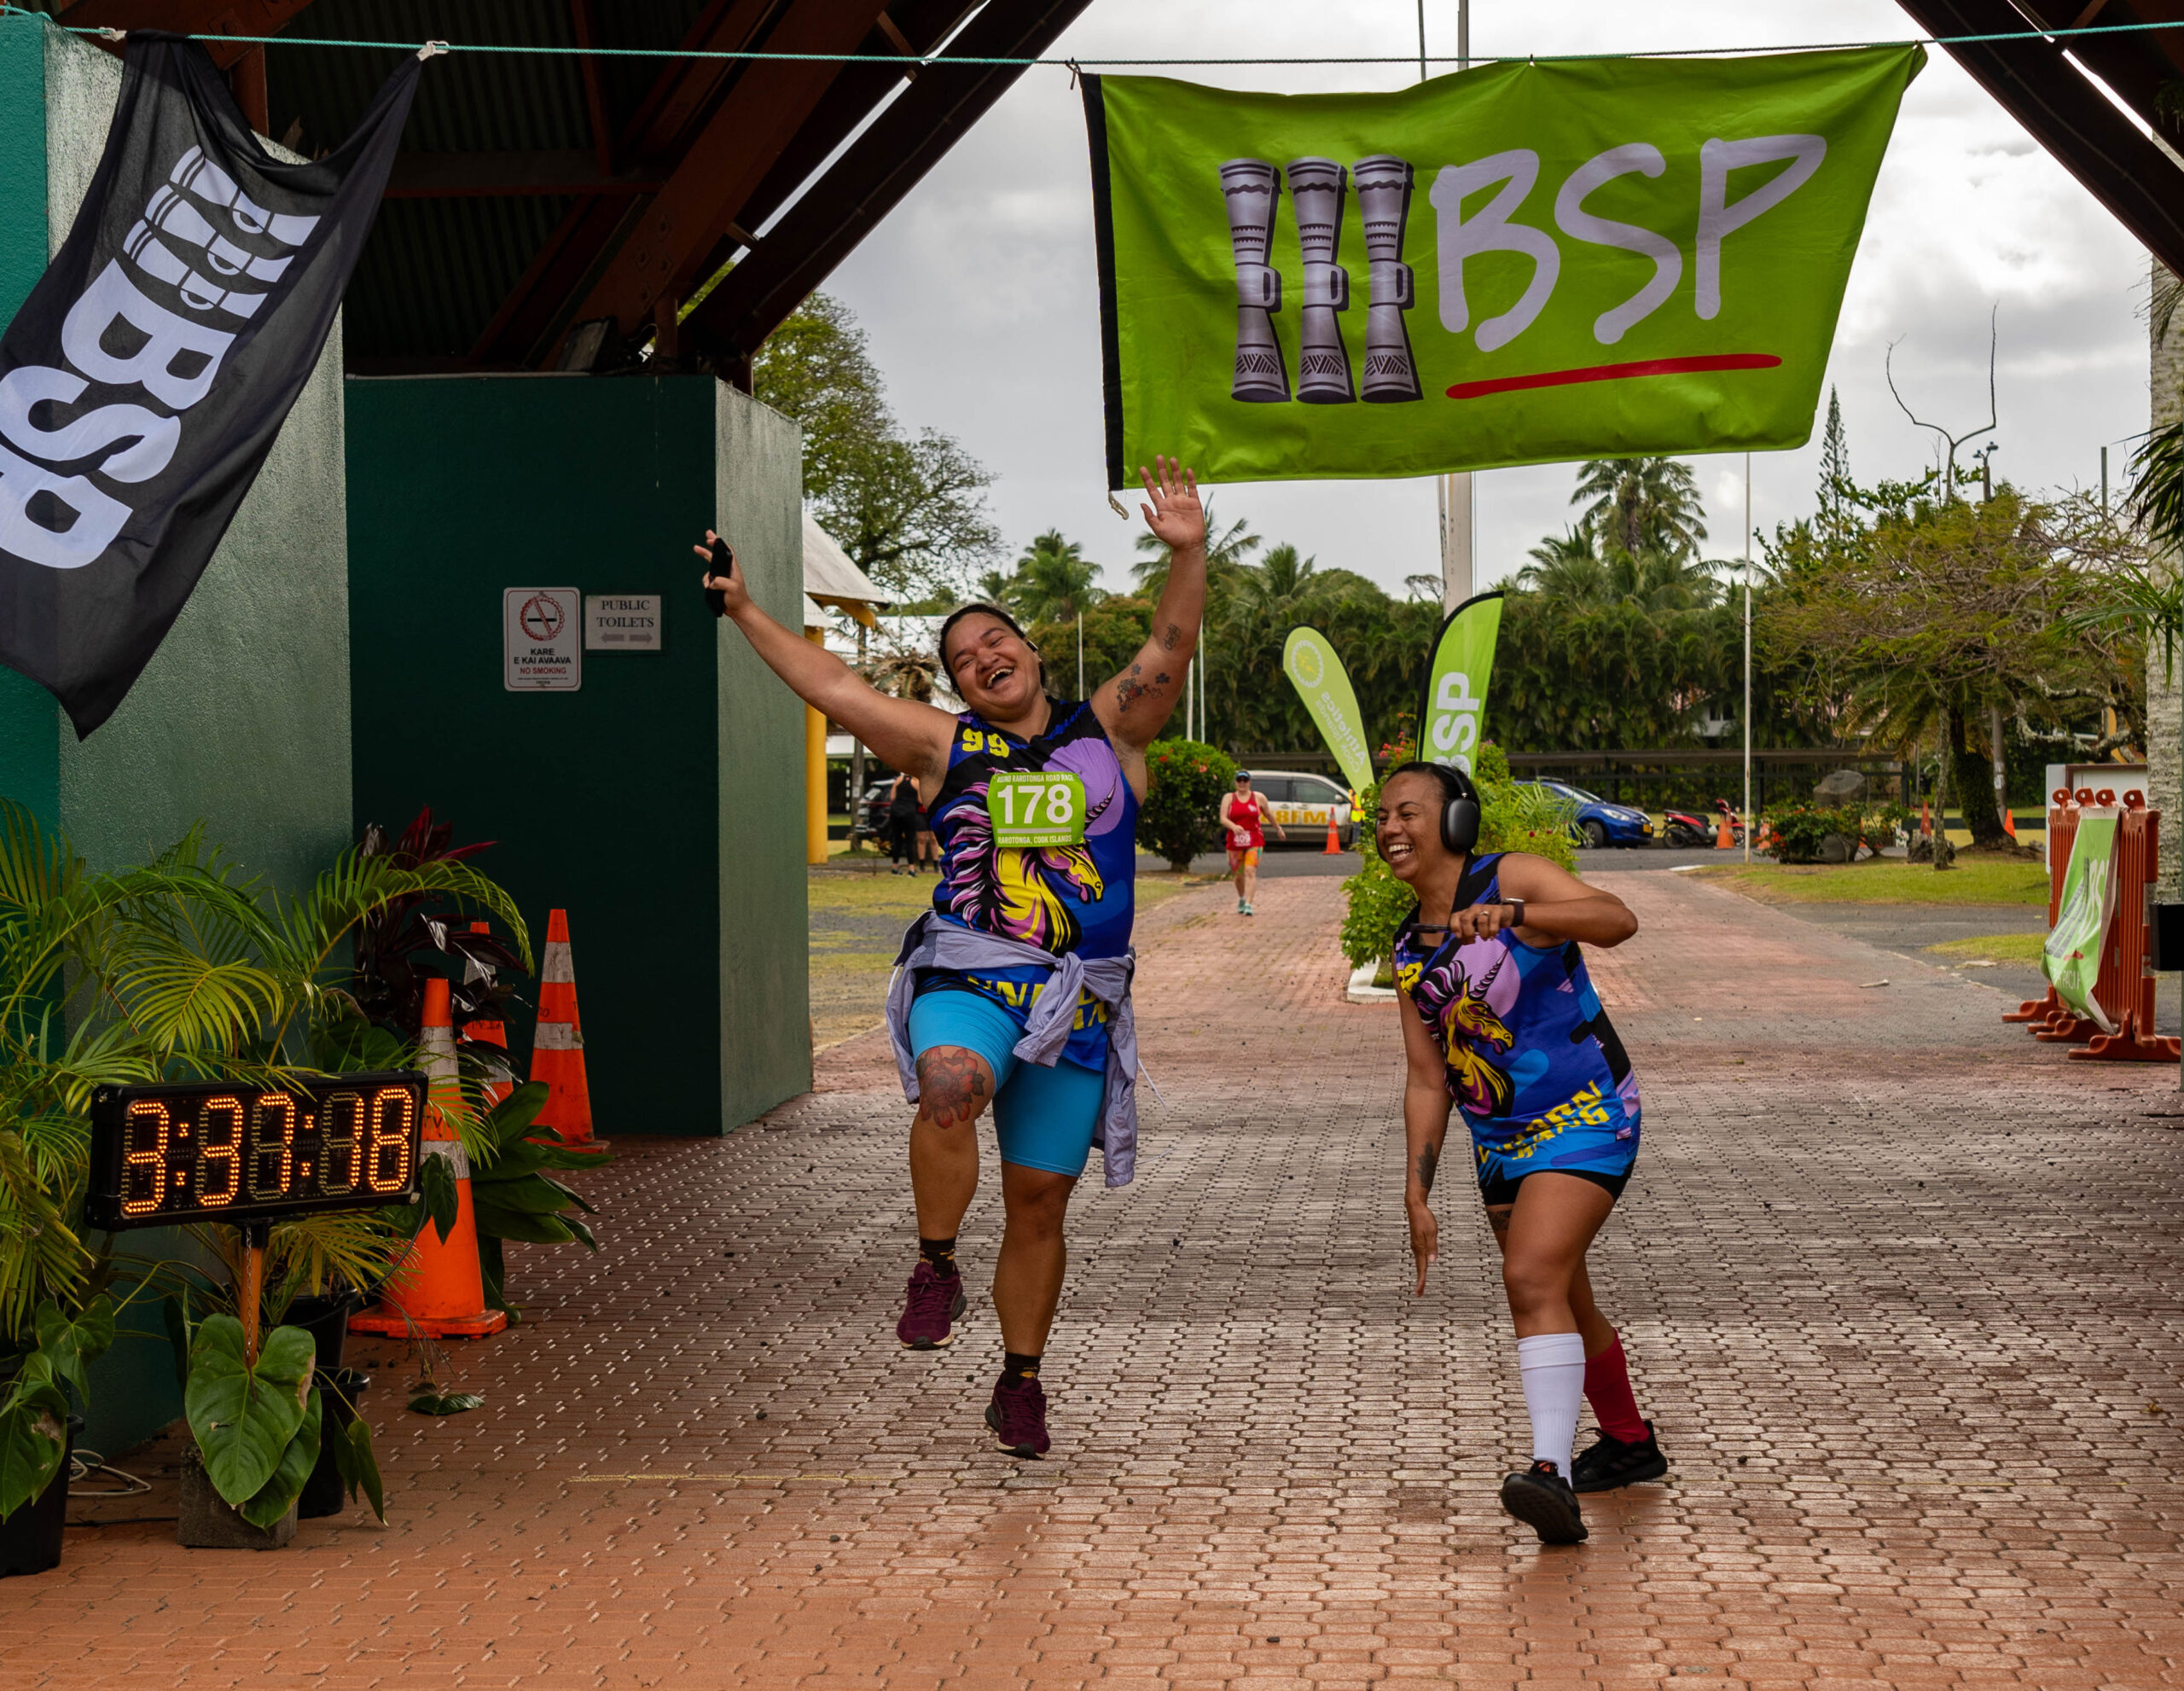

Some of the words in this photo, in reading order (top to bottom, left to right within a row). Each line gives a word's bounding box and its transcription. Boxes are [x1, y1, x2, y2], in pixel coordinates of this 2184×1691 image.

[1429, 134, 1827, 352] BSP
[0, 258, 237, 569] BSP
[601, 600, 650, 610] PUBLIC
[596, 617, 654, 628] TOILETS
[961, 728, 1010, 758] 99
[1012, 775, 1045, 783] RAROTONGA
[1045, 774, 1060, 782] ROAD
[997, 783, 1073, 824] 178
[1033, 835, 1049, 844] COOK
[1049, 834, 1072, 843] ISLANDS
[122, 1088, 413, 1213] 3:37:18
